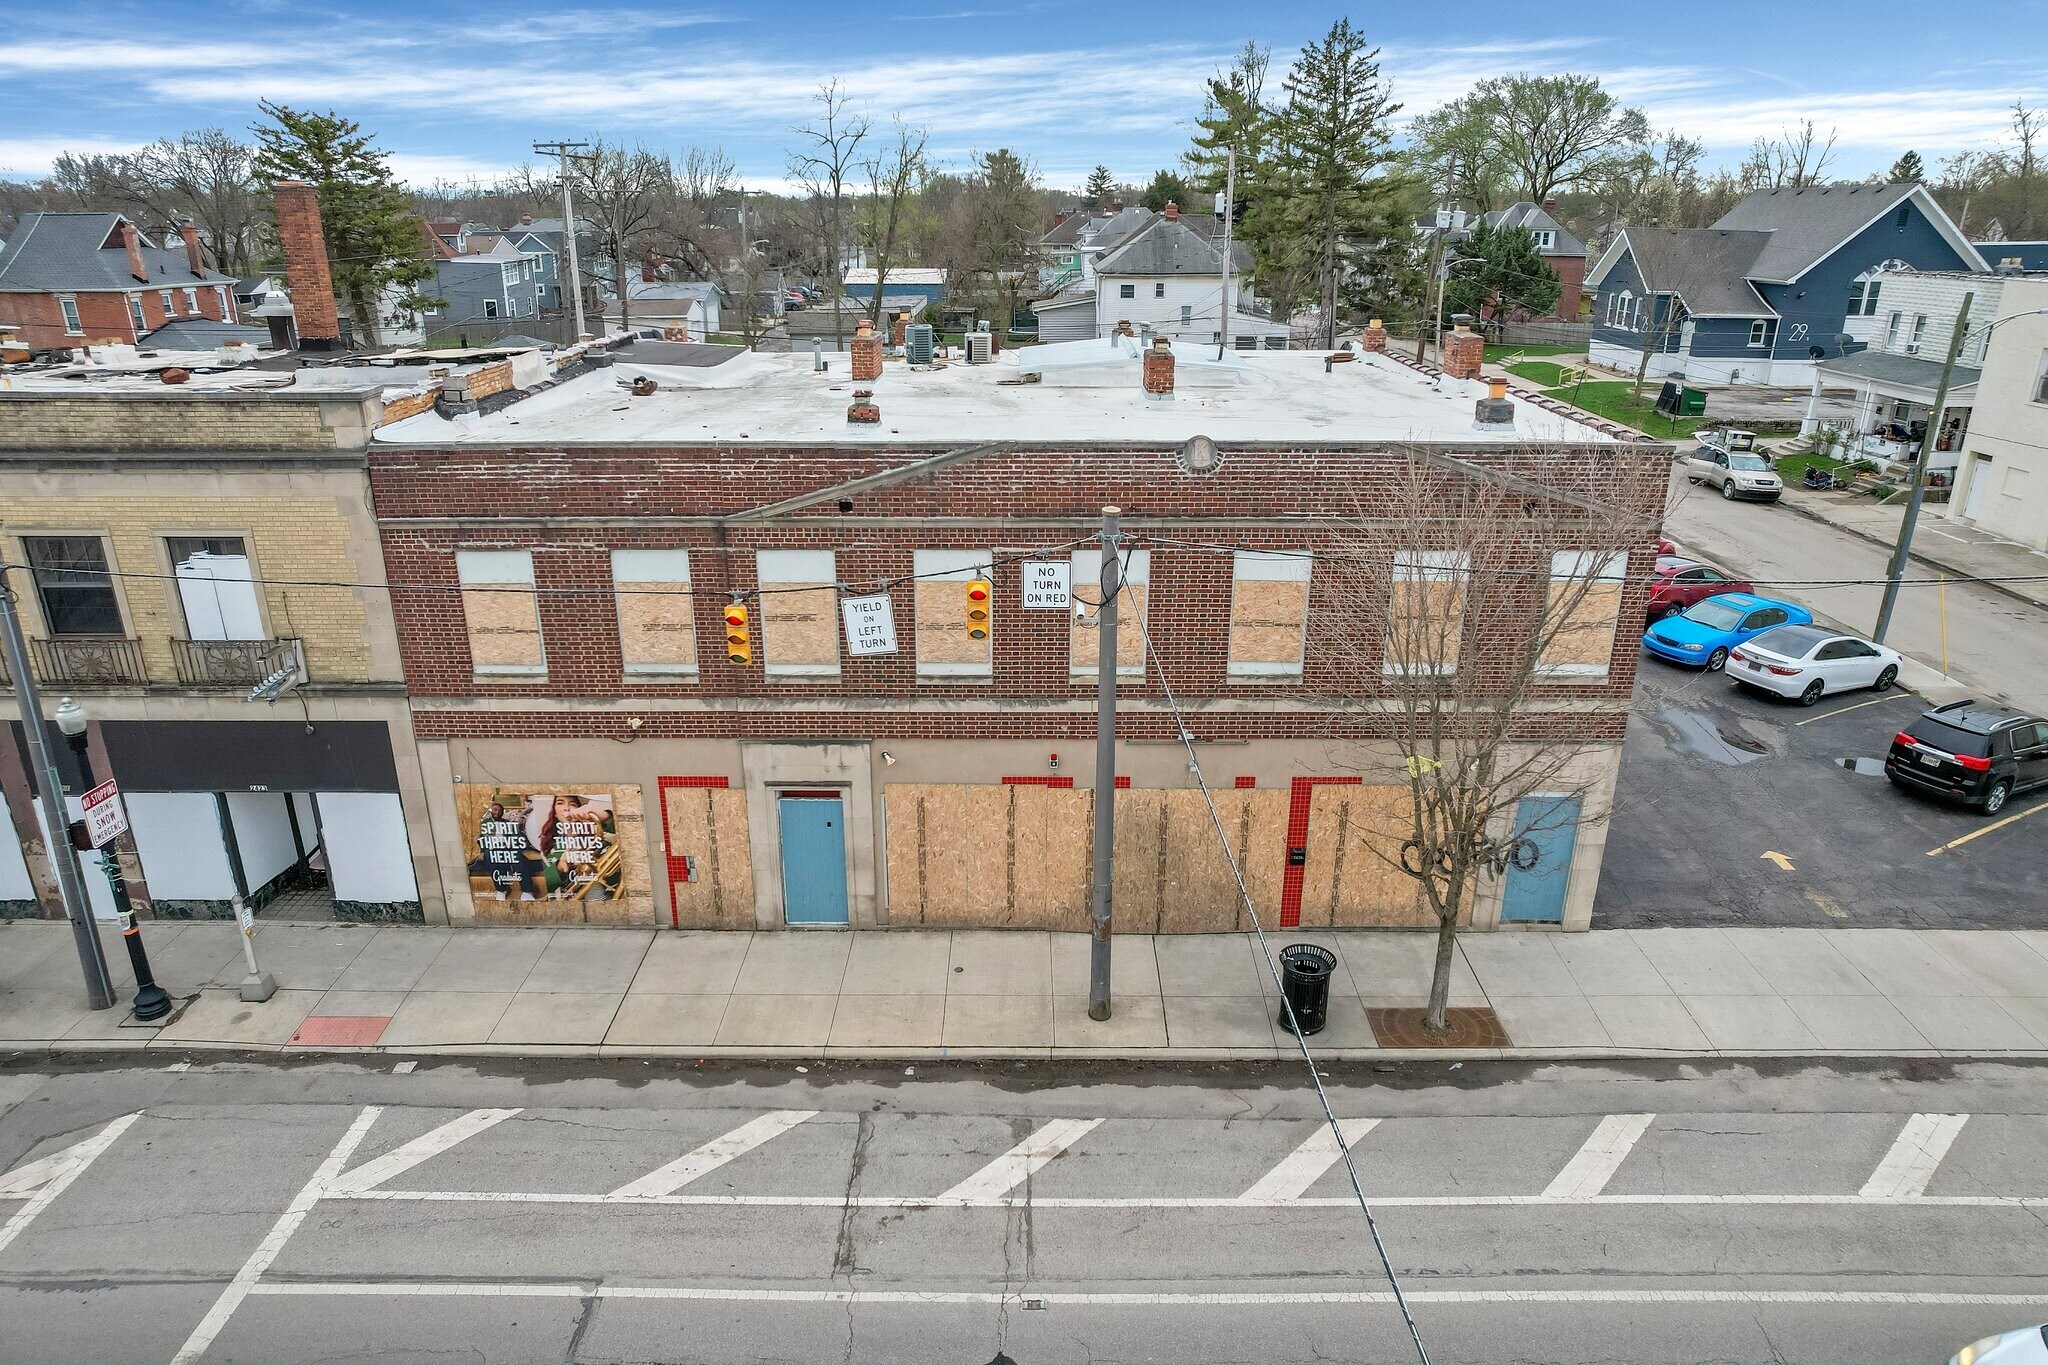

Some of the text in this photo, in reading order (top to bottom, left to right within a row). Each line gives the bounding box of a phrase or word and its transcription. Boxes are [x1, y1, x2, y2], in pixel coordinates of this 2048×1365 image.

[1038, 567, 1055, 577] NO
[1033, 580, 1061, 590] TURN
[1027, 593, 1067, 603] ON RED
[852, 602, 882, 613] YIELD
[863, 615, 875, 623] ON
[858, 625, 882, 636] LEFT
[859, 638, 887, 649] TURN
[82, 782, 116, 809] NO STOPPING
[92, 800, 114, 818] DURING
[96, 811, 116, 829] SNOW
[93, 820, 124, 844] EMERGENCY
[481, 821, 519, 835] SPIRIT
[555, 821, 596, 835] SPIRIT
[477, 836, 527, 850] THRIVES
[553, 836, 604, 849] THRIVES
[489, 850, 520, 864] HERE
[565, 850, 596, 864] HERE
